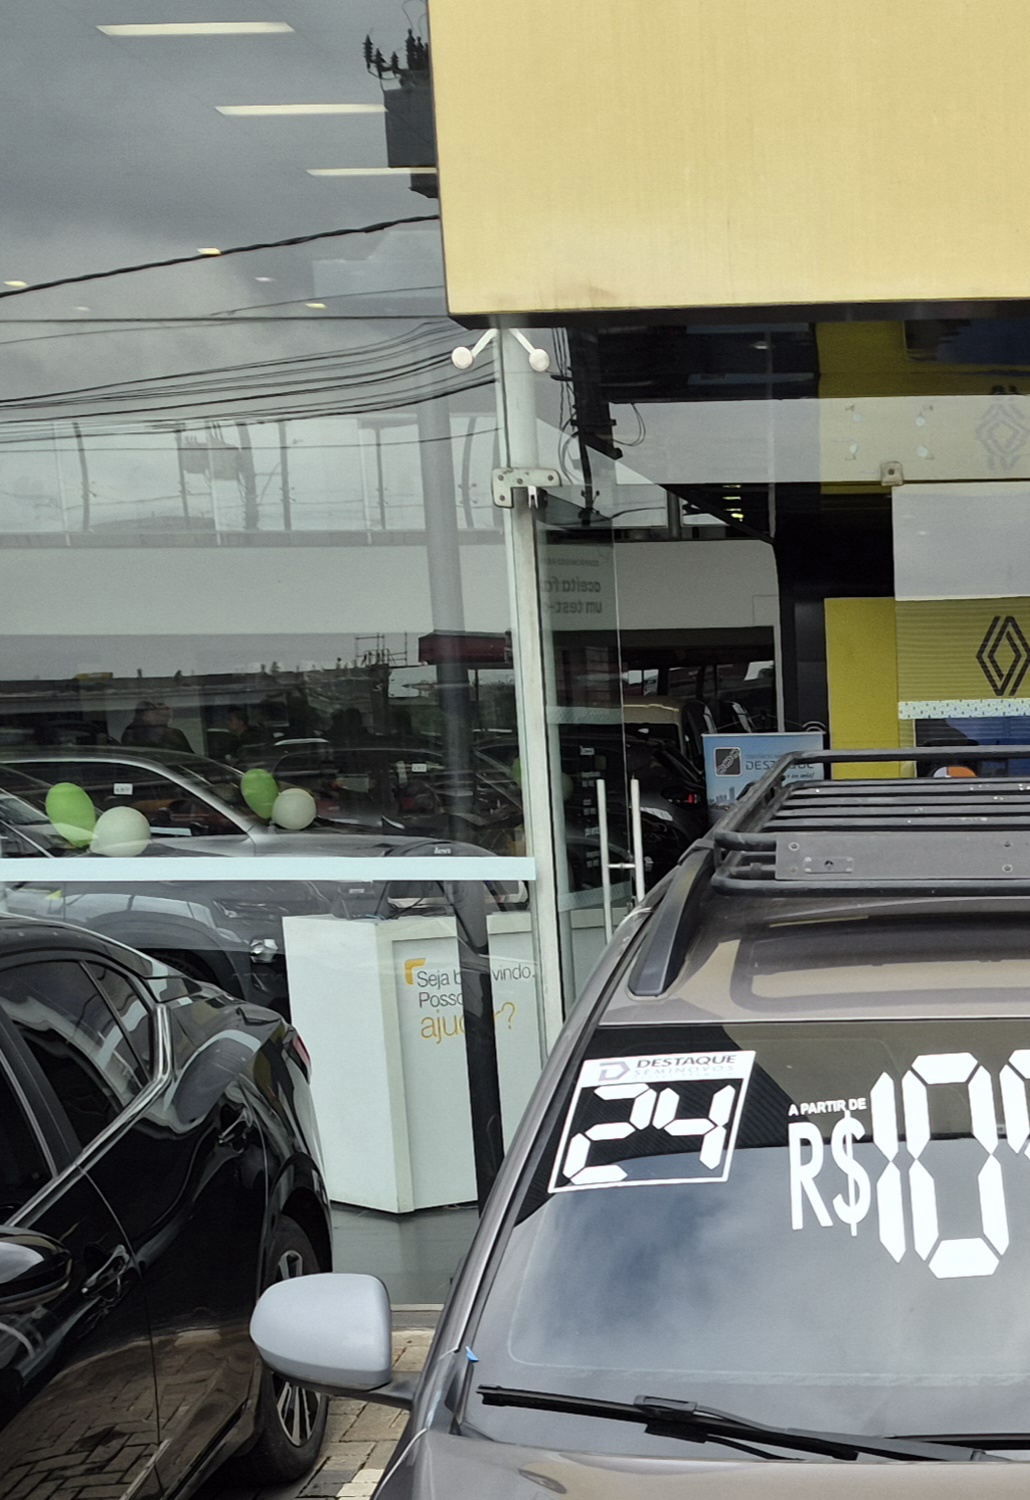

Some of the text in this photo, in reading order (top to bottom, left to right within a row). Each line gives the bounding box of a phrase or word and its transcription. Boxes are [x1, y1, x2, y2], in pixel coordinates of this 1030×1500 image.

[416, 970, 450, 990] Seja
[636, 1054, 737, 1069] DESTAQUE
[788, 1097, 868, 1117] A PARTIR DE
[562, 1082, 736, 1185] 24
